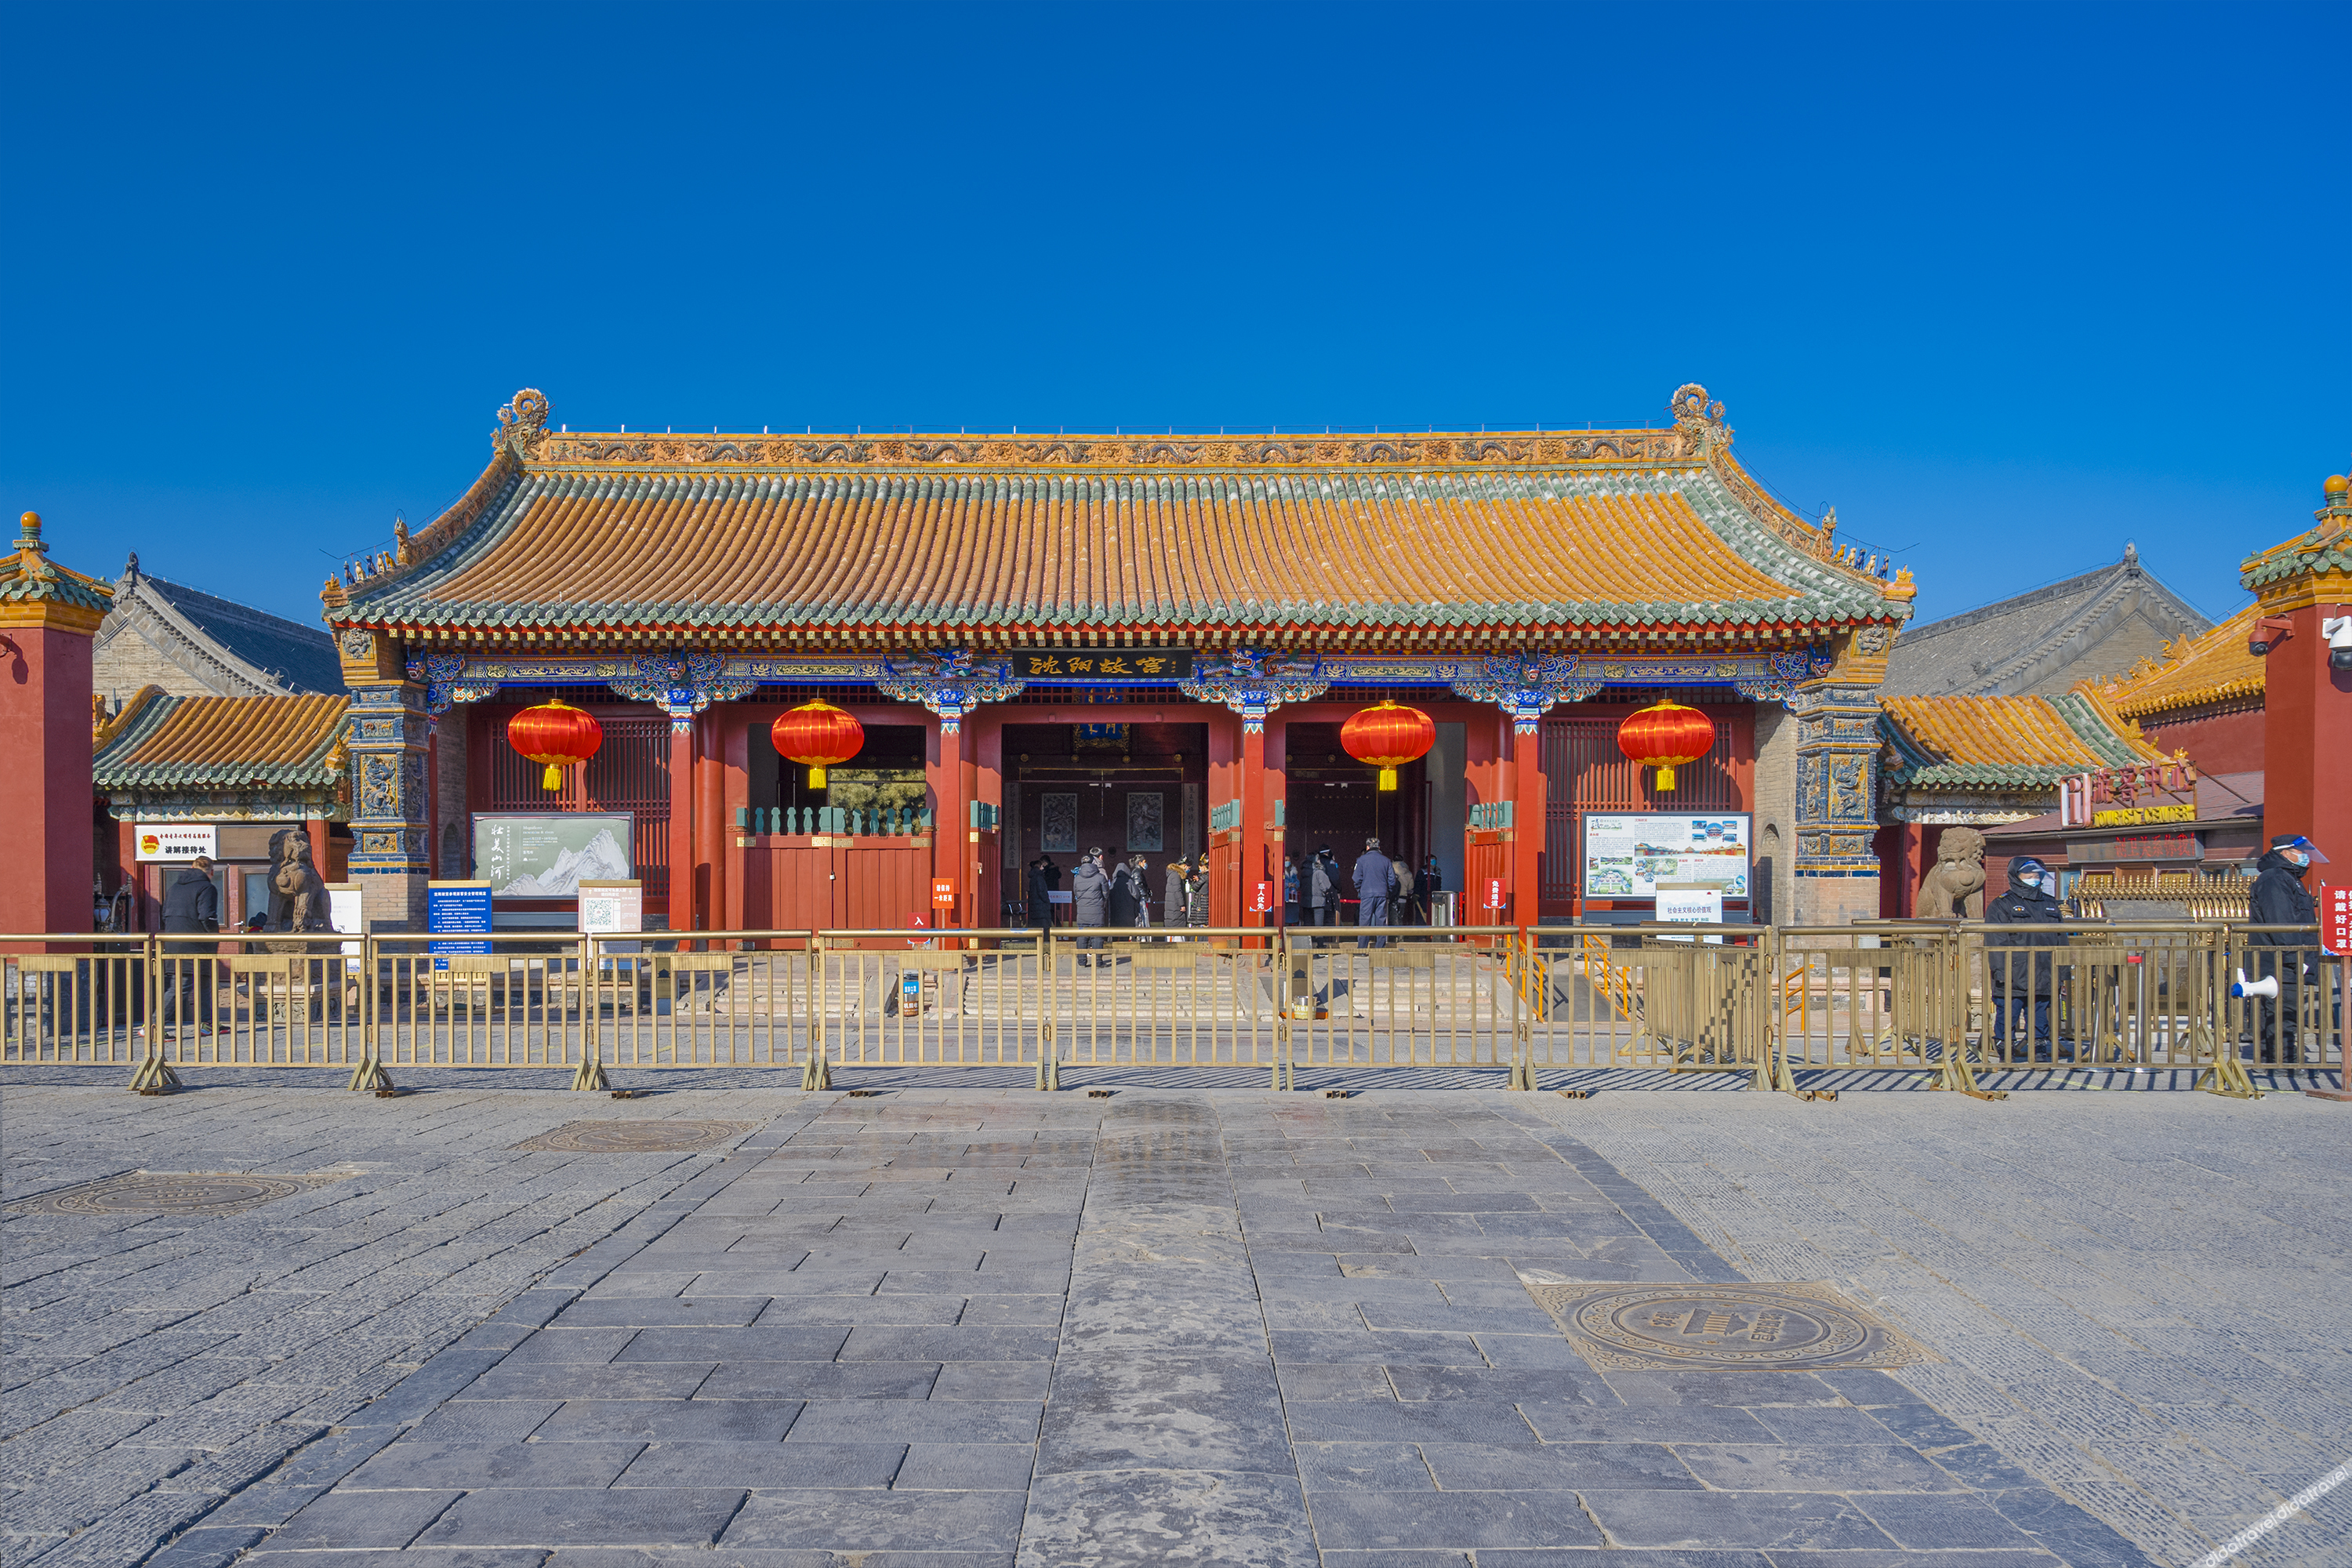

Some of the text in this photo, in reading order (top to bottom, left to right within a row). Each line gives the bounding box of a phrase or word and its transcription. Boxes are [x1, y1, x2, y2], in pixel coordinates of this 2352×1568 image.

[1029, 655, 1167, 674] 沈阳故宫
[2092, 759, 2197, 804] 游客中心
[2144, 804, 2195, 823] CENTER
[490, 824, 505, 880] 壮美山河
[2334, 890, 2347, 949] 请戴好口罩
